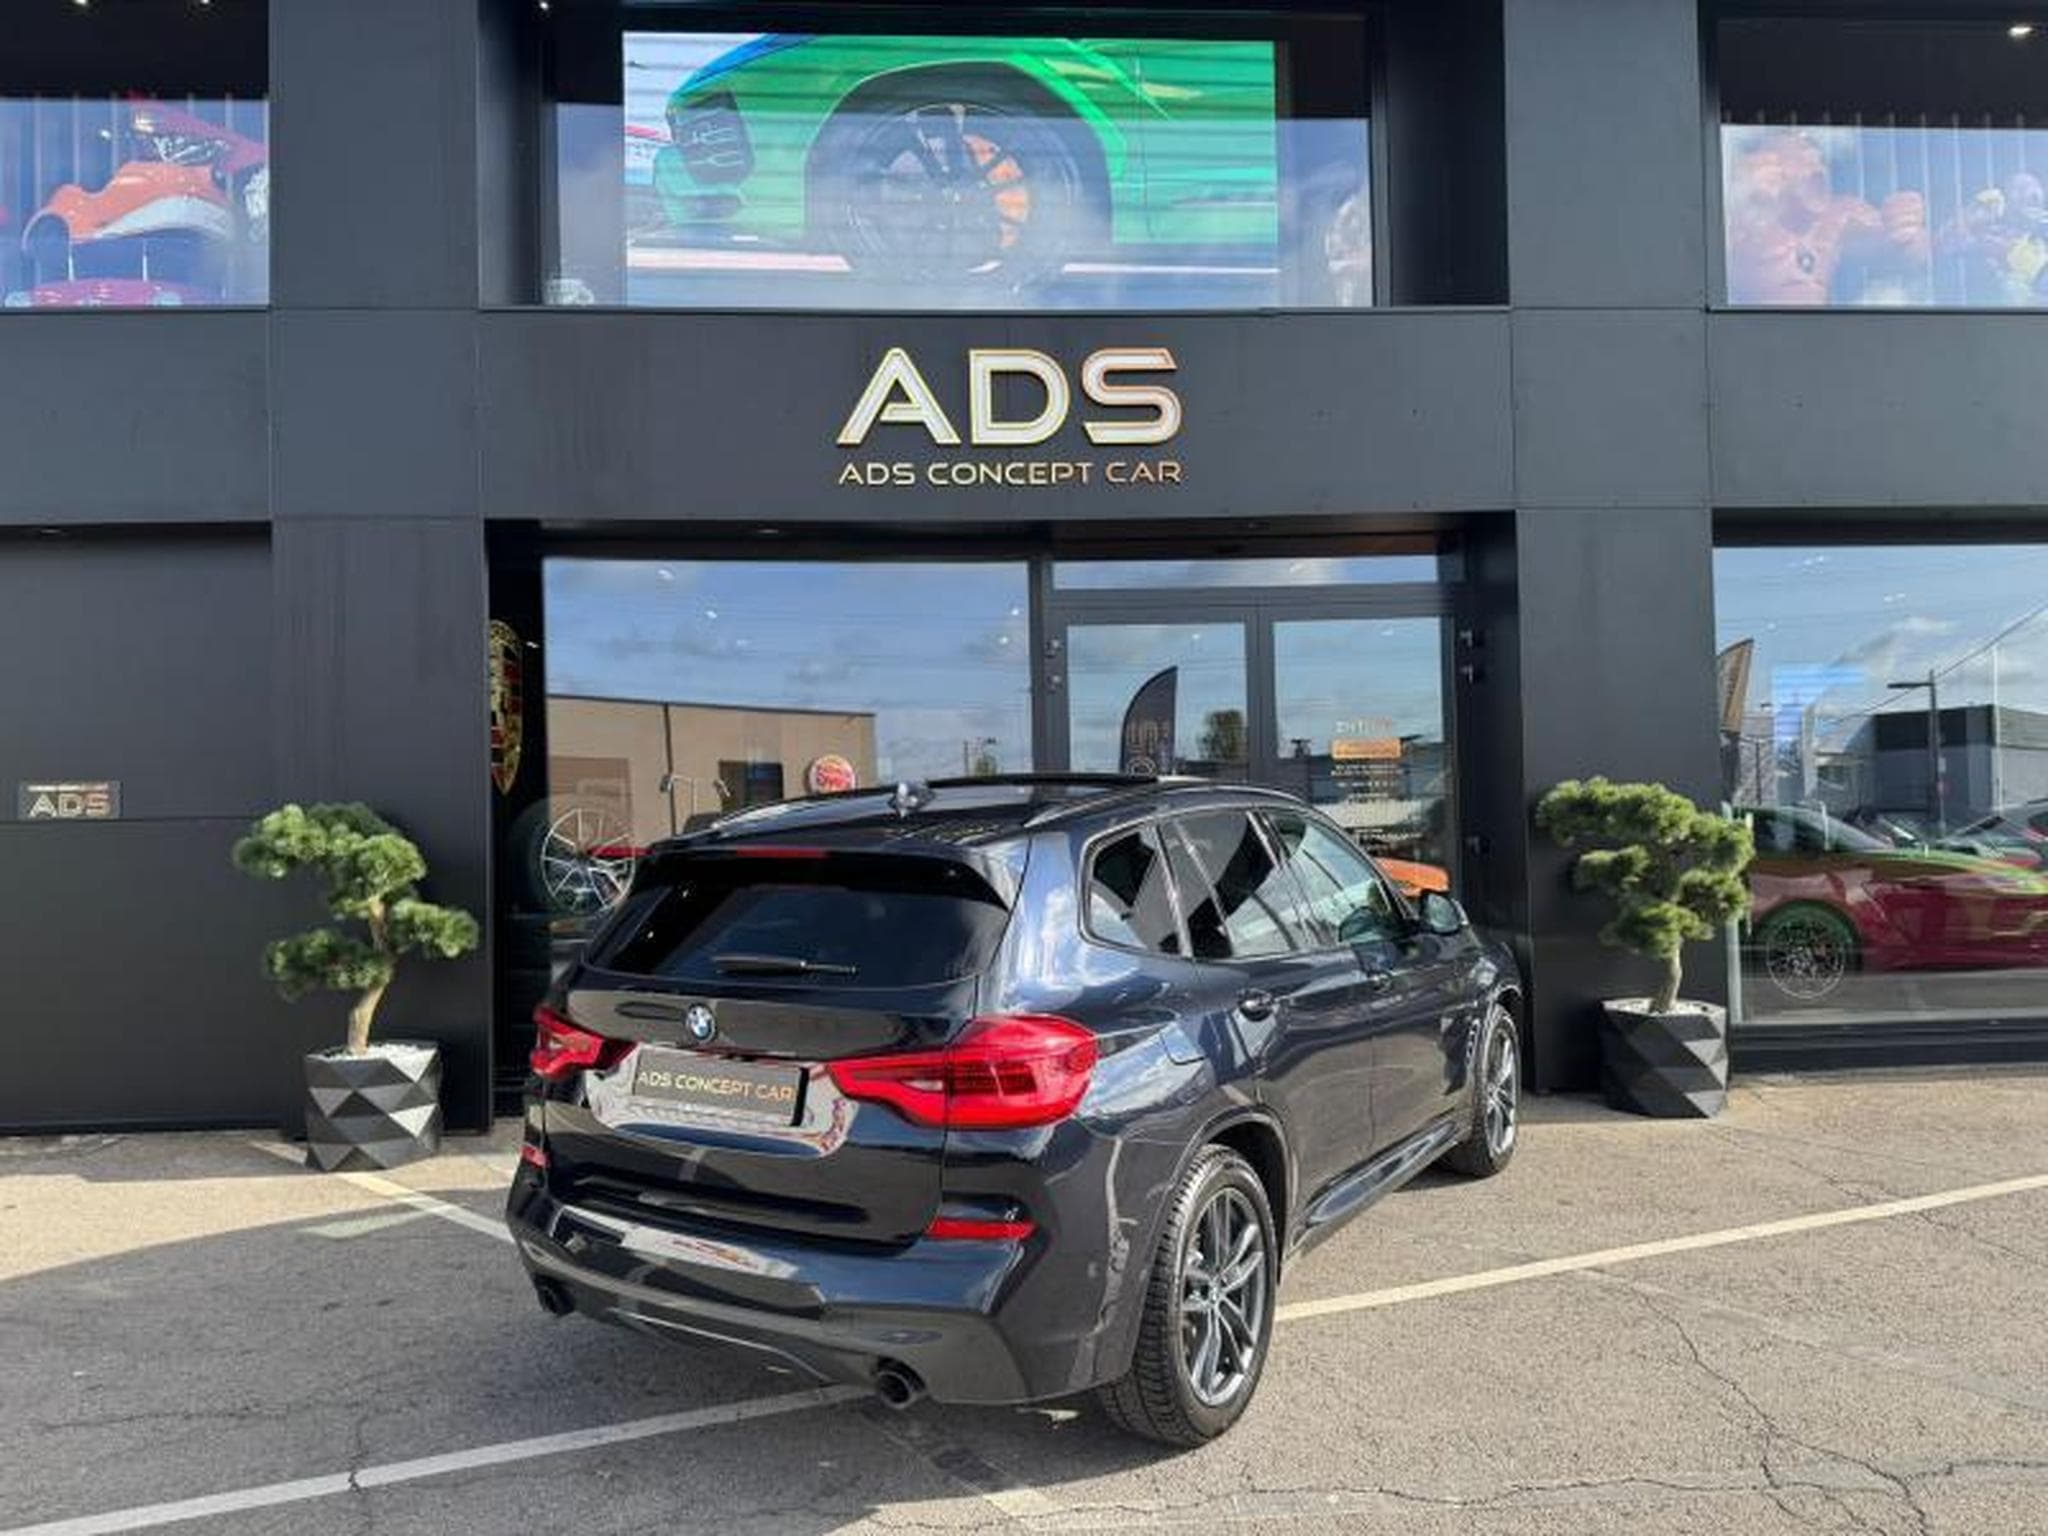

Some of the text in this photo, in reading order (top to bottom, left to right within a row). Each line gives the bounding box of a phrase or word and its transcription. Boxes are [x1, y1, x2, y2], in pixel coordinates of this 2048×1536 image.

[836, 346, 1183, 445] ADS
[838, 460, 1183, 486] ADS CONCEPT CAR
[27, 792, 112, 818] ADS
[638, 1071, 795, 1101] ADS CONCEPT CAR
